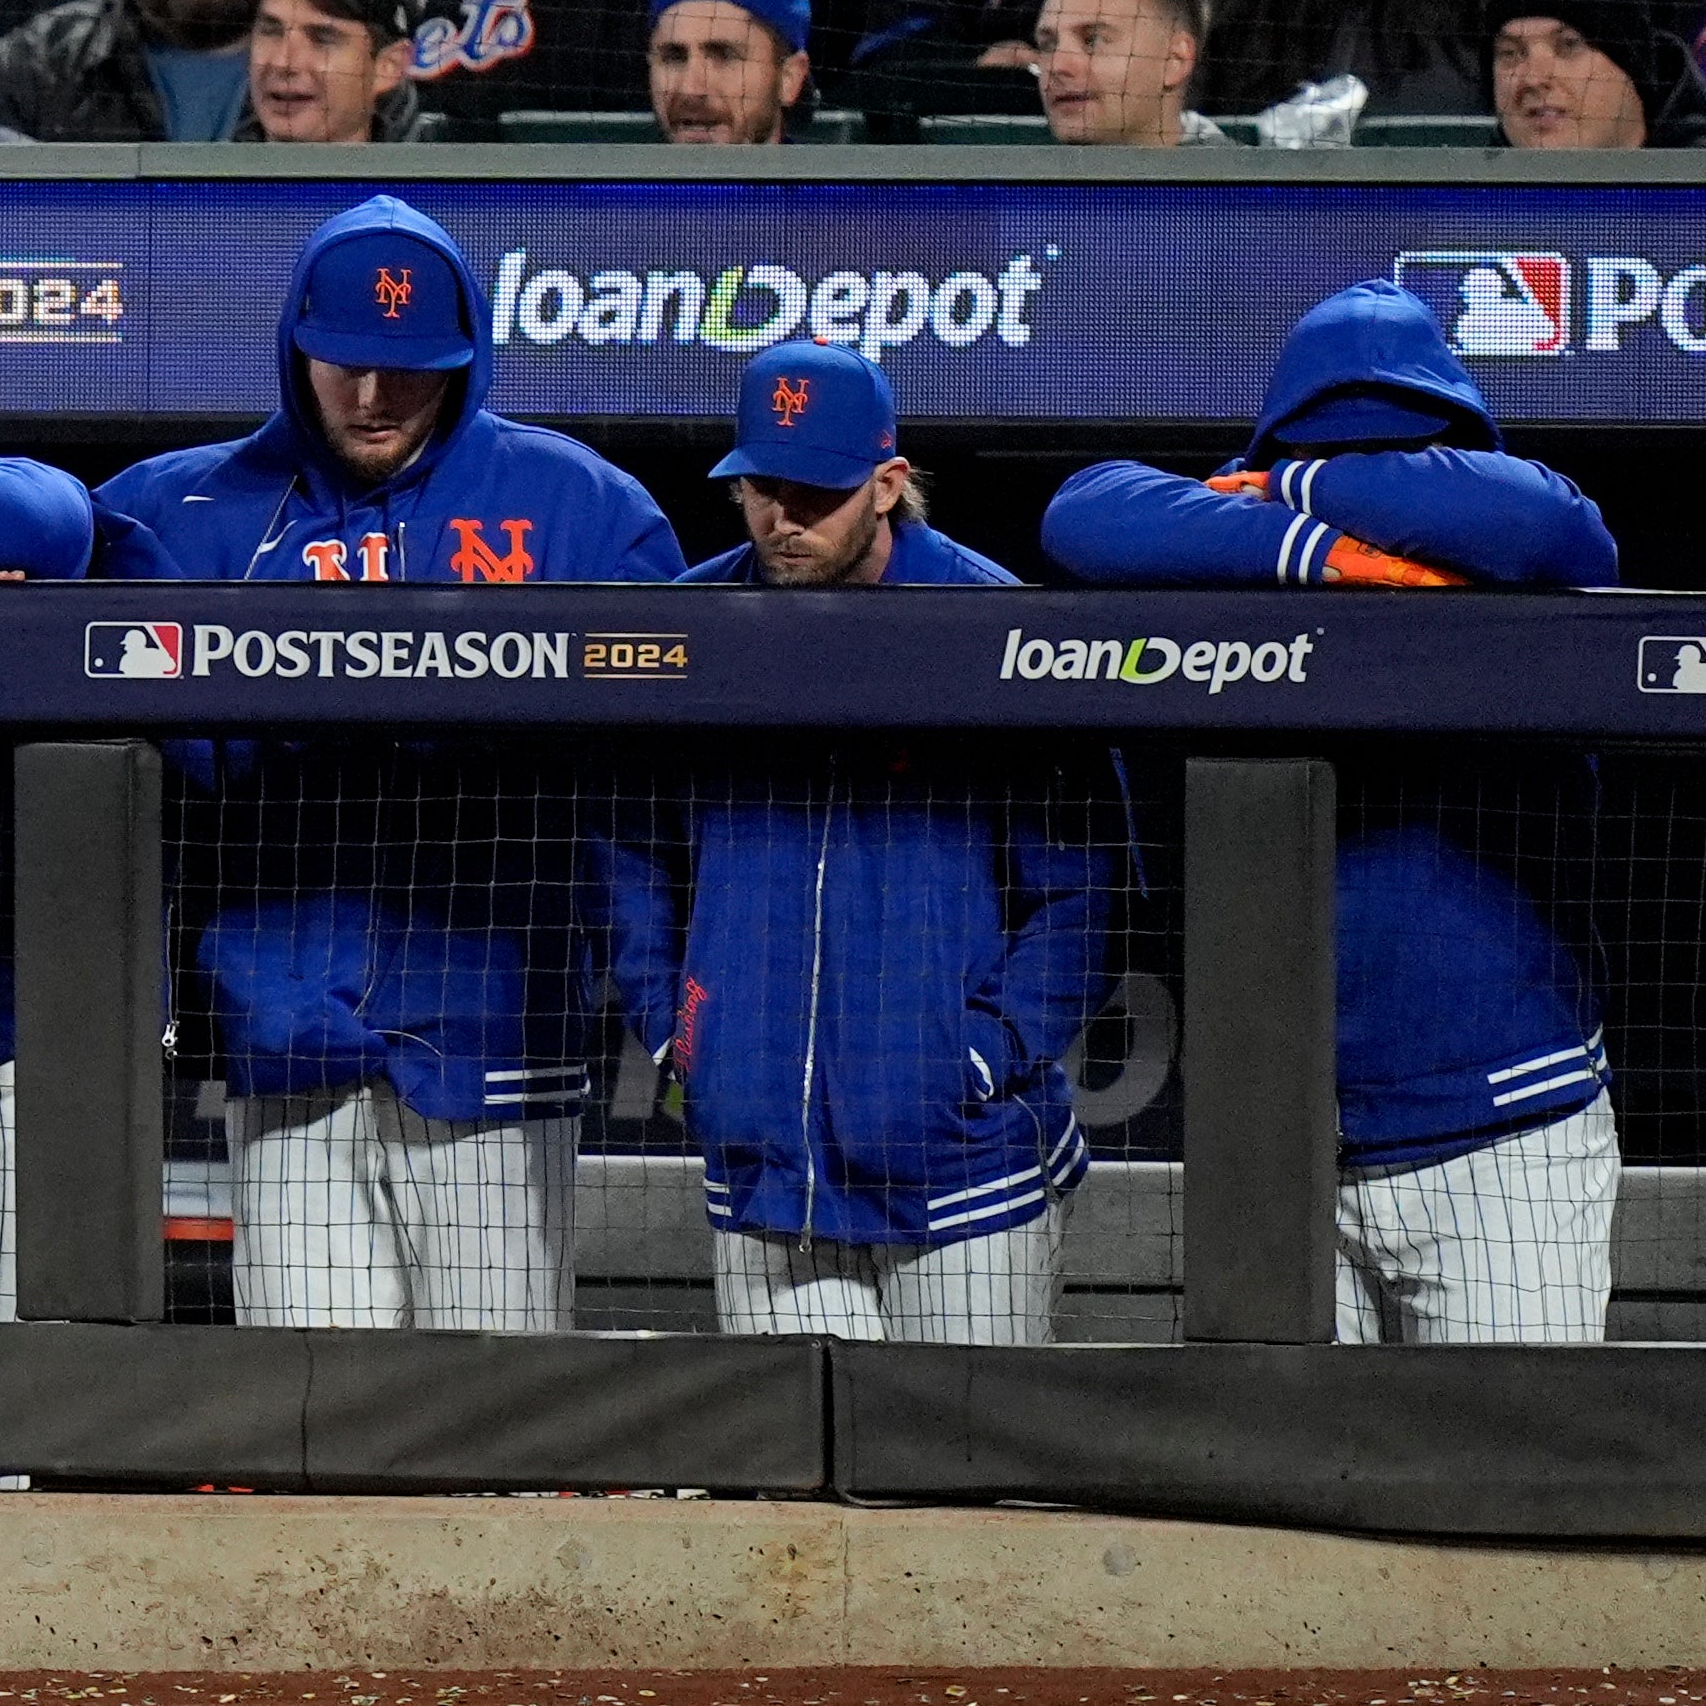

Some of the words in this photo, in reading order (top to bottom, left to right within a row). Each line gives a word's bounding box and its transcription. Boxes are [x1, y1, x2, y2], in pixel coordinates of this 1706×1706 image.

[491, 246, 1044, 364] loanDepot
[192, 624, 570, 679] POSTSEASON
[583, 643, 689, 670] 2024
[999, 628, 1314, 694] loanDepot
